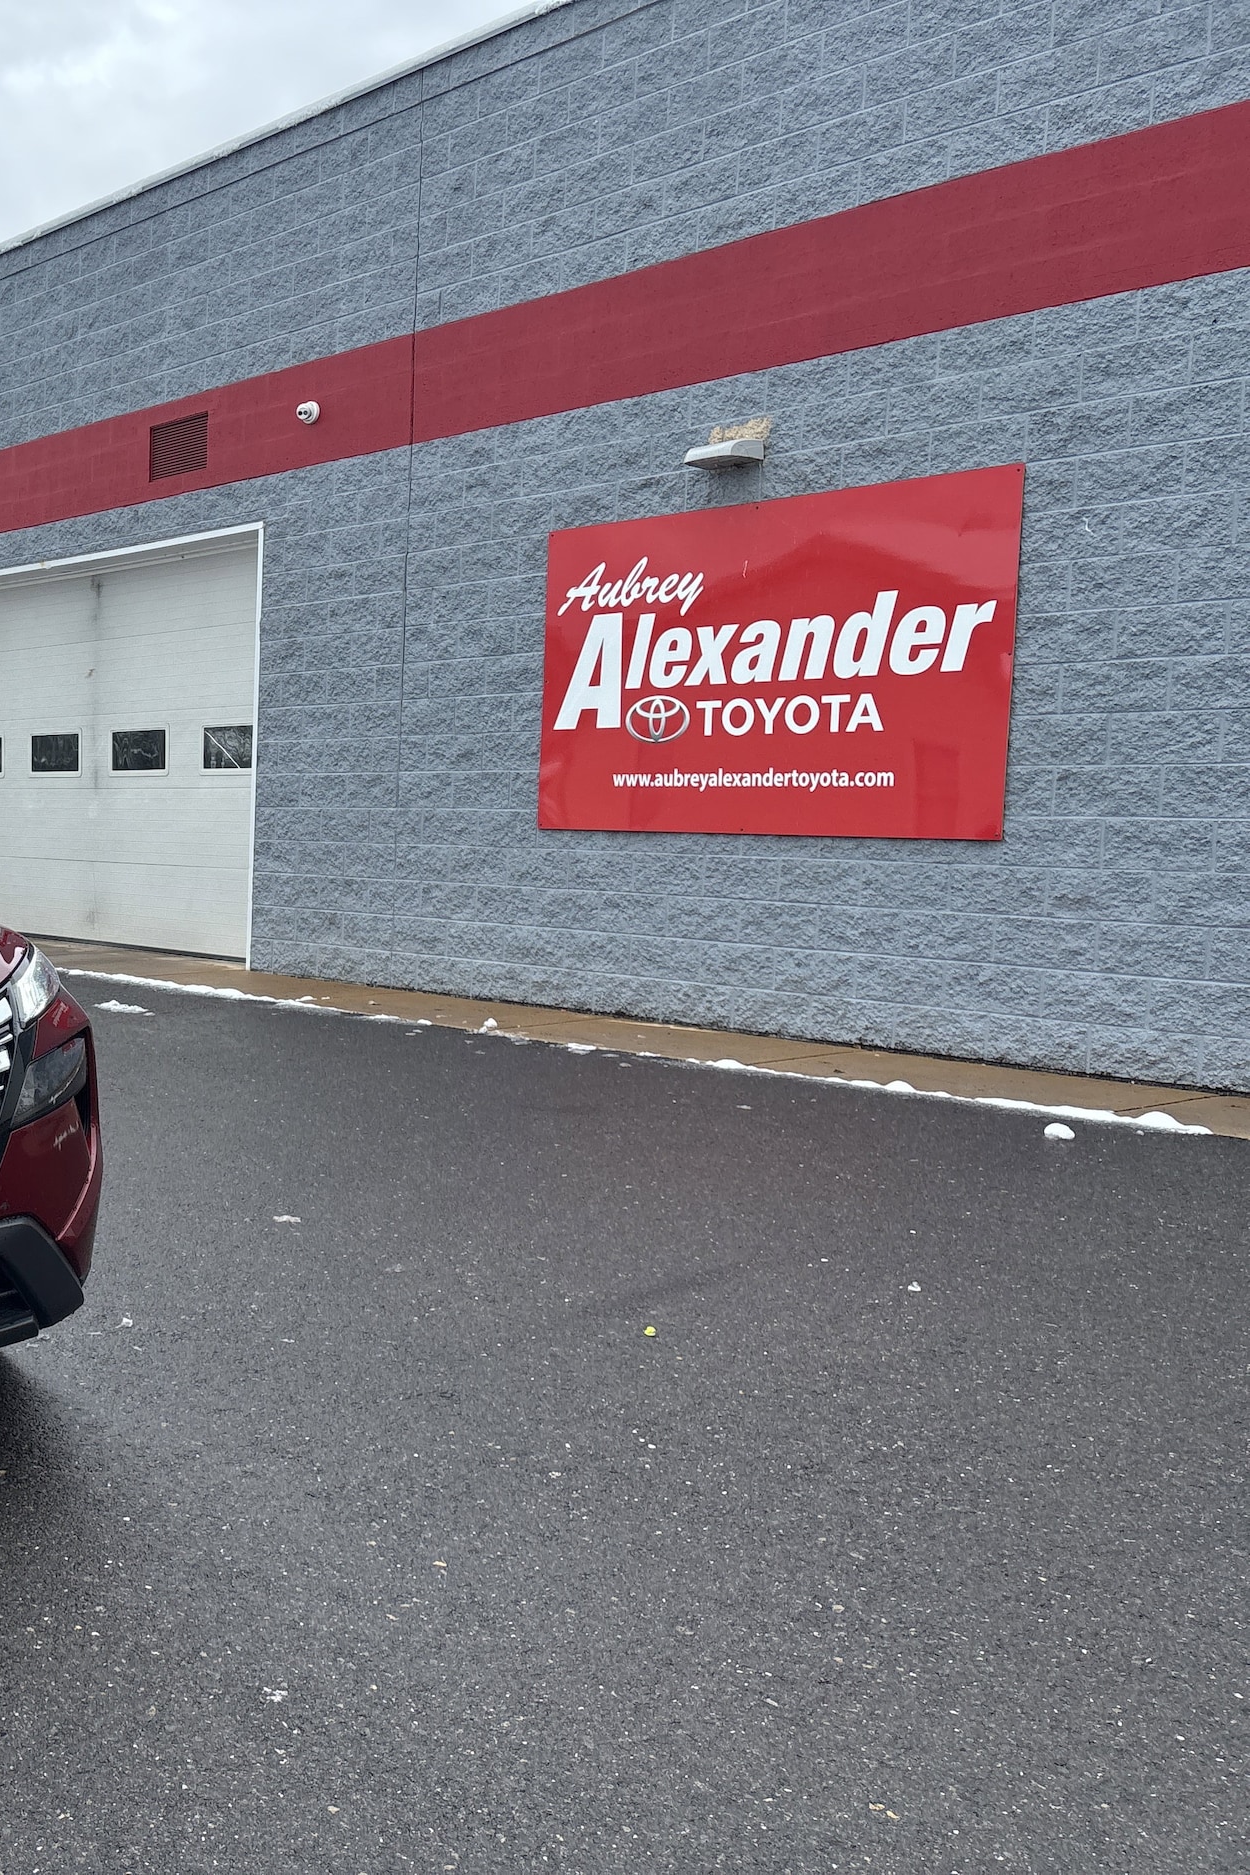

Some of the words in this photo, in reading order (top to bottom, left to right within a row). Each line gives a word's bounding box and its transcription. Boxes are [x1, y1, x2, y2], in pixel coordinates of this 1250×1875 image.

[557, 556, 704, 616] Aubrey
[553, 590, 997, 730] Alexander
[696, 693, 884, 737] TOYOTA
[612, 767, 895, 791] www.aubreyalexandertoyota.com
